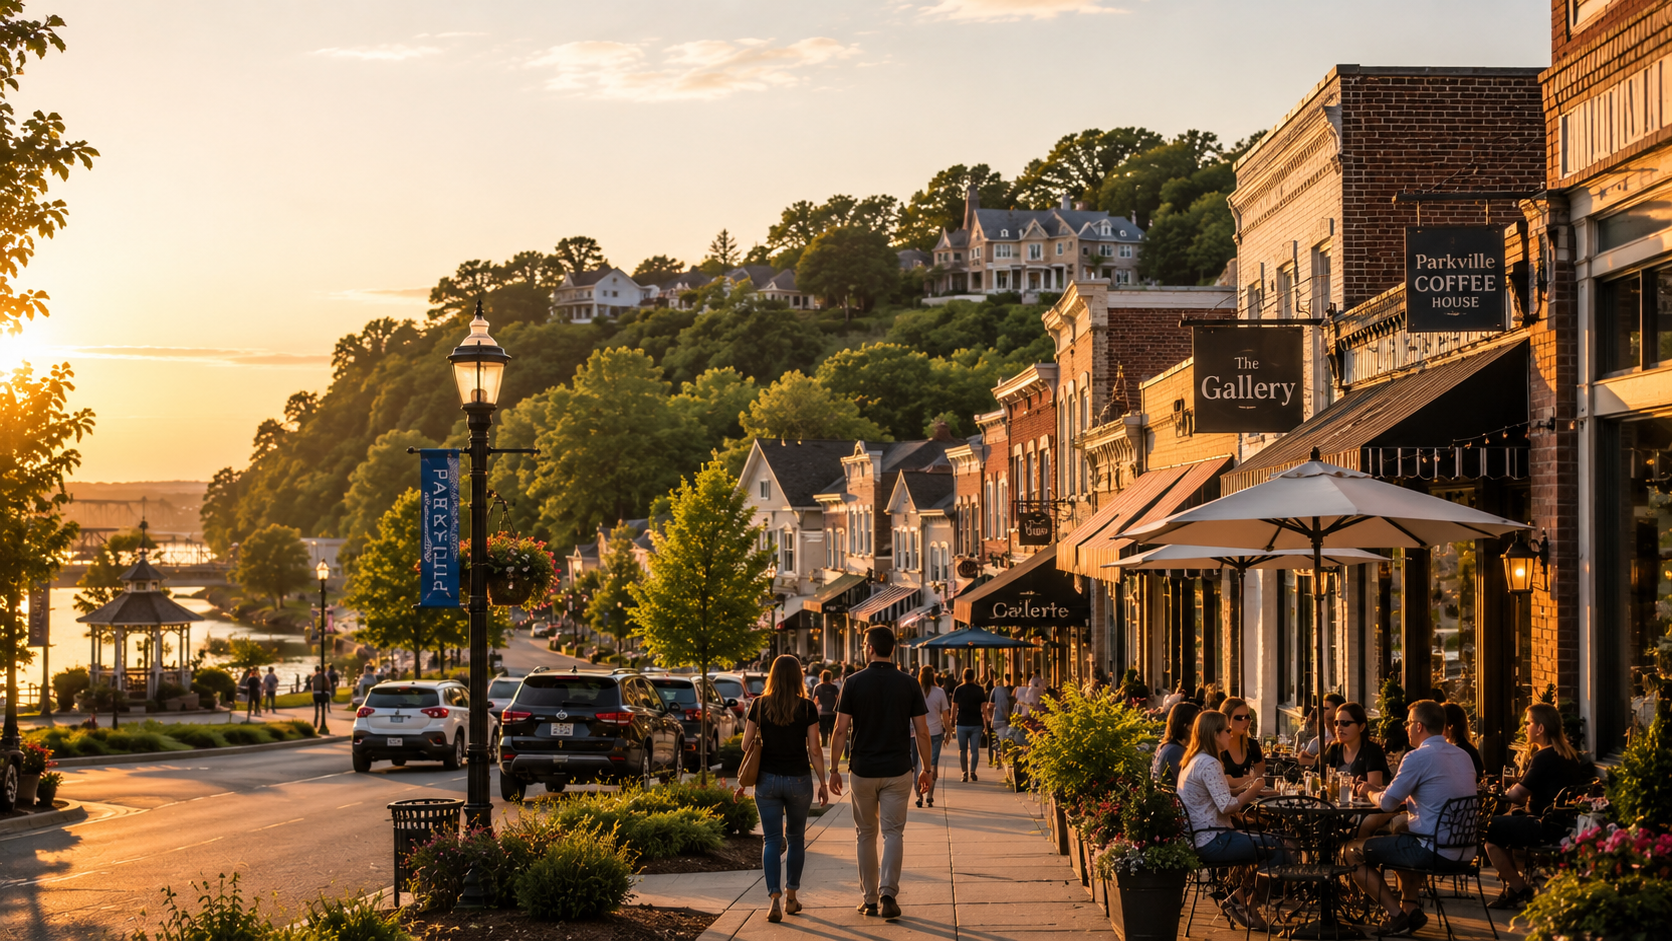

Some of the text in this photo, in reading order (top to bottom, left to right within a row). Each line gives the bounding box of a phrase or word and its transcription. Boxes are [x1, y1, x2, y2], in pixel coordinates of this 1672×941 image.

[1415, 252, 1496, 270] Parkville
[1414, 274, 1497, 293] COFFEE
[1432, 296, 1480, 308] HOUSE
[1234, 356, 1260, 370] The
[1201, 374, 1297, 407] Gallery
